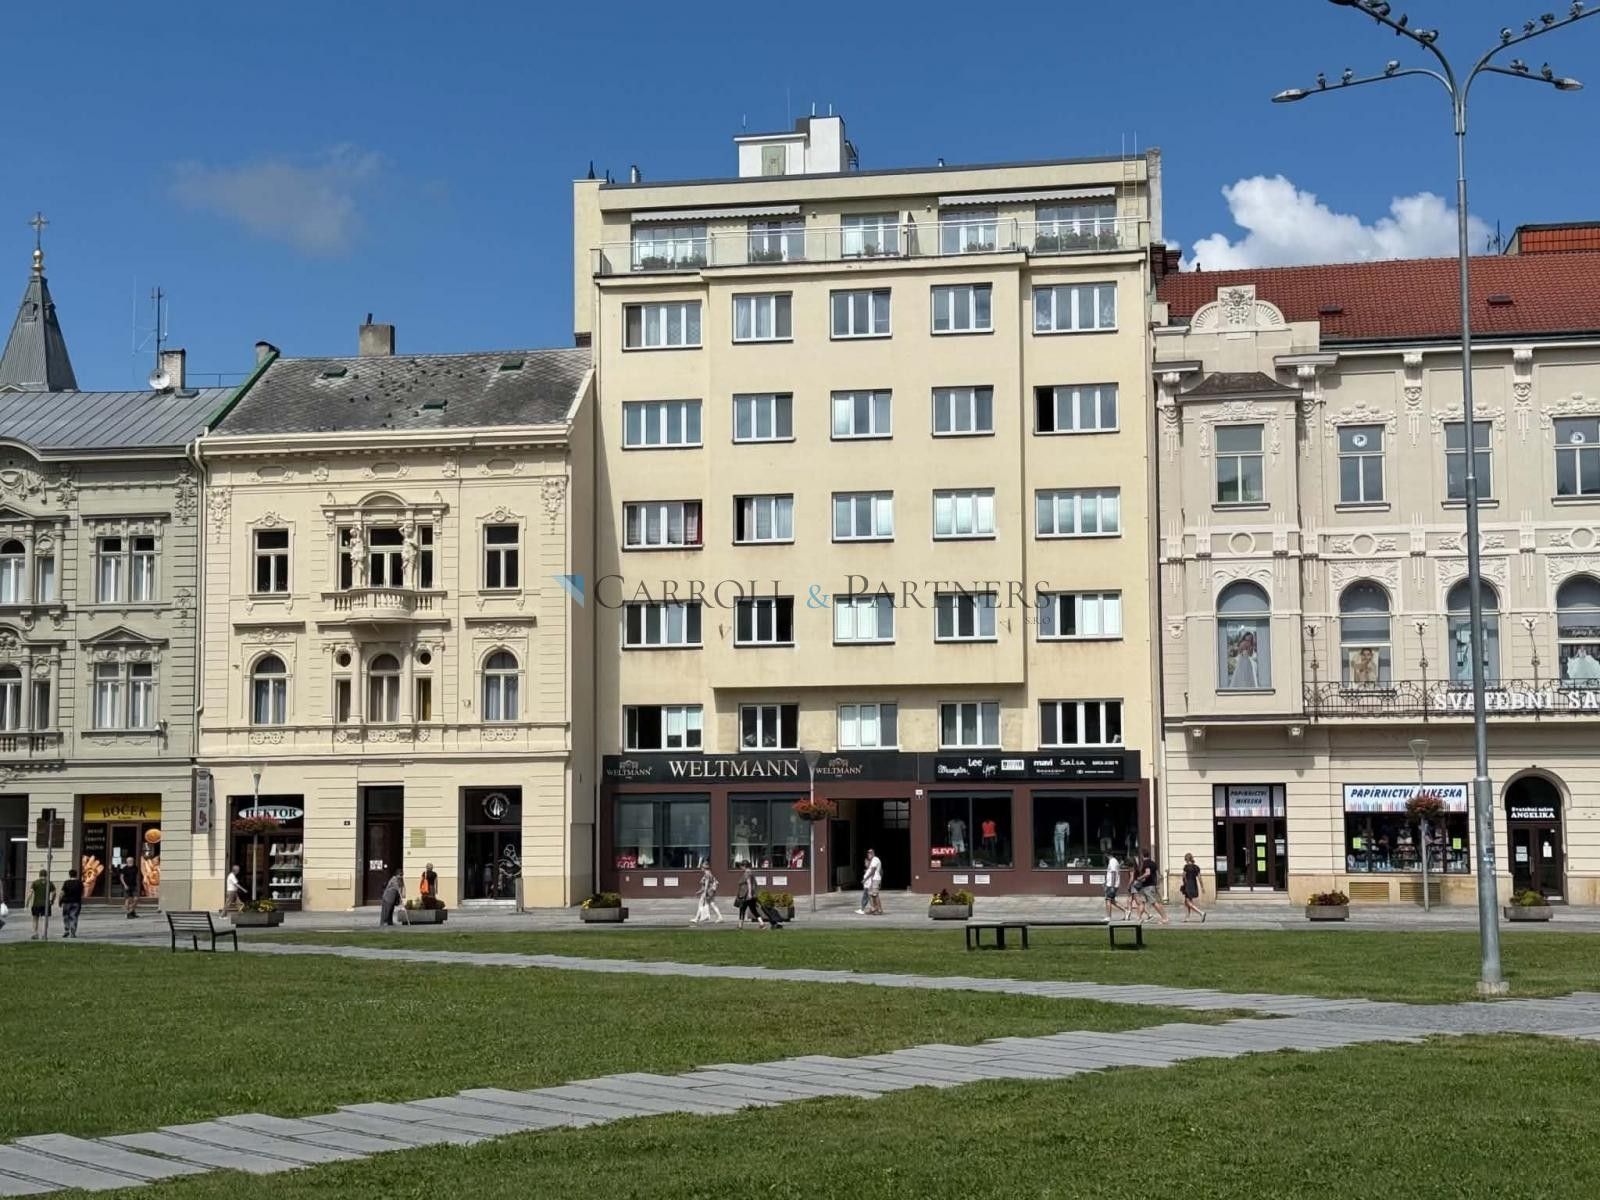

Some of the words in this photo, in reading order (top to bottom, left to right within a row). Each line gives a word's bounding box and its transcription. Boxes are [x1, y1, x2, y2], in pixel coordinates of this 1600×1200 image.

[968, 758, 983, 767] Lee
[1033, 758, 1053, 766] mavi
[607, 768, 651, 776] WELTMANN
[669, 760, 799, 777] WELTMANN
[816, 767, 861, 775] WELTMANN
[931, 847, 955, 855] SLEVY
